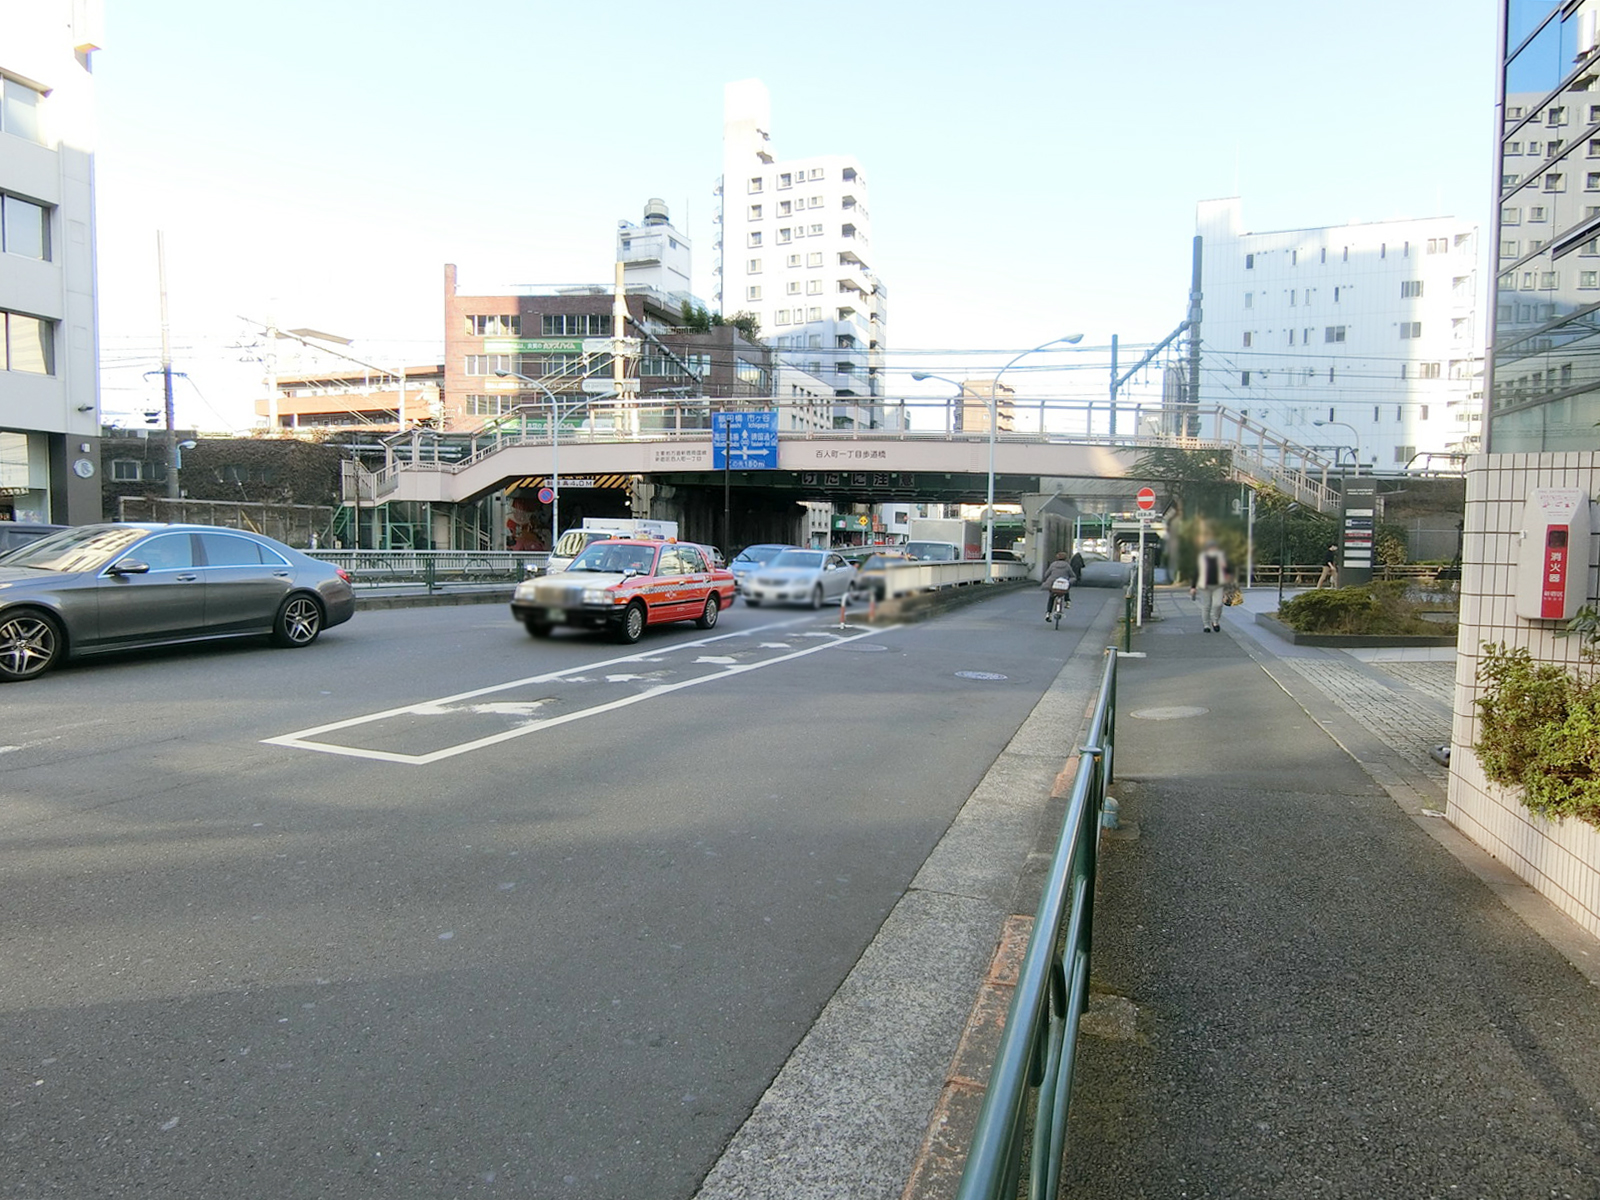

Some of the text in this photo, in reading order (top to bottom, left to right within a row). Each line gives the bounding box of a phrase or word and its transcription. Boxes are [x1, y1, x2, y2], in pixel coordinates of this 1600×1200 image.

[815, 450, 887, 459] 百人町一丁目歩道橋
[1548, 552, 1562, 583] 消火器
